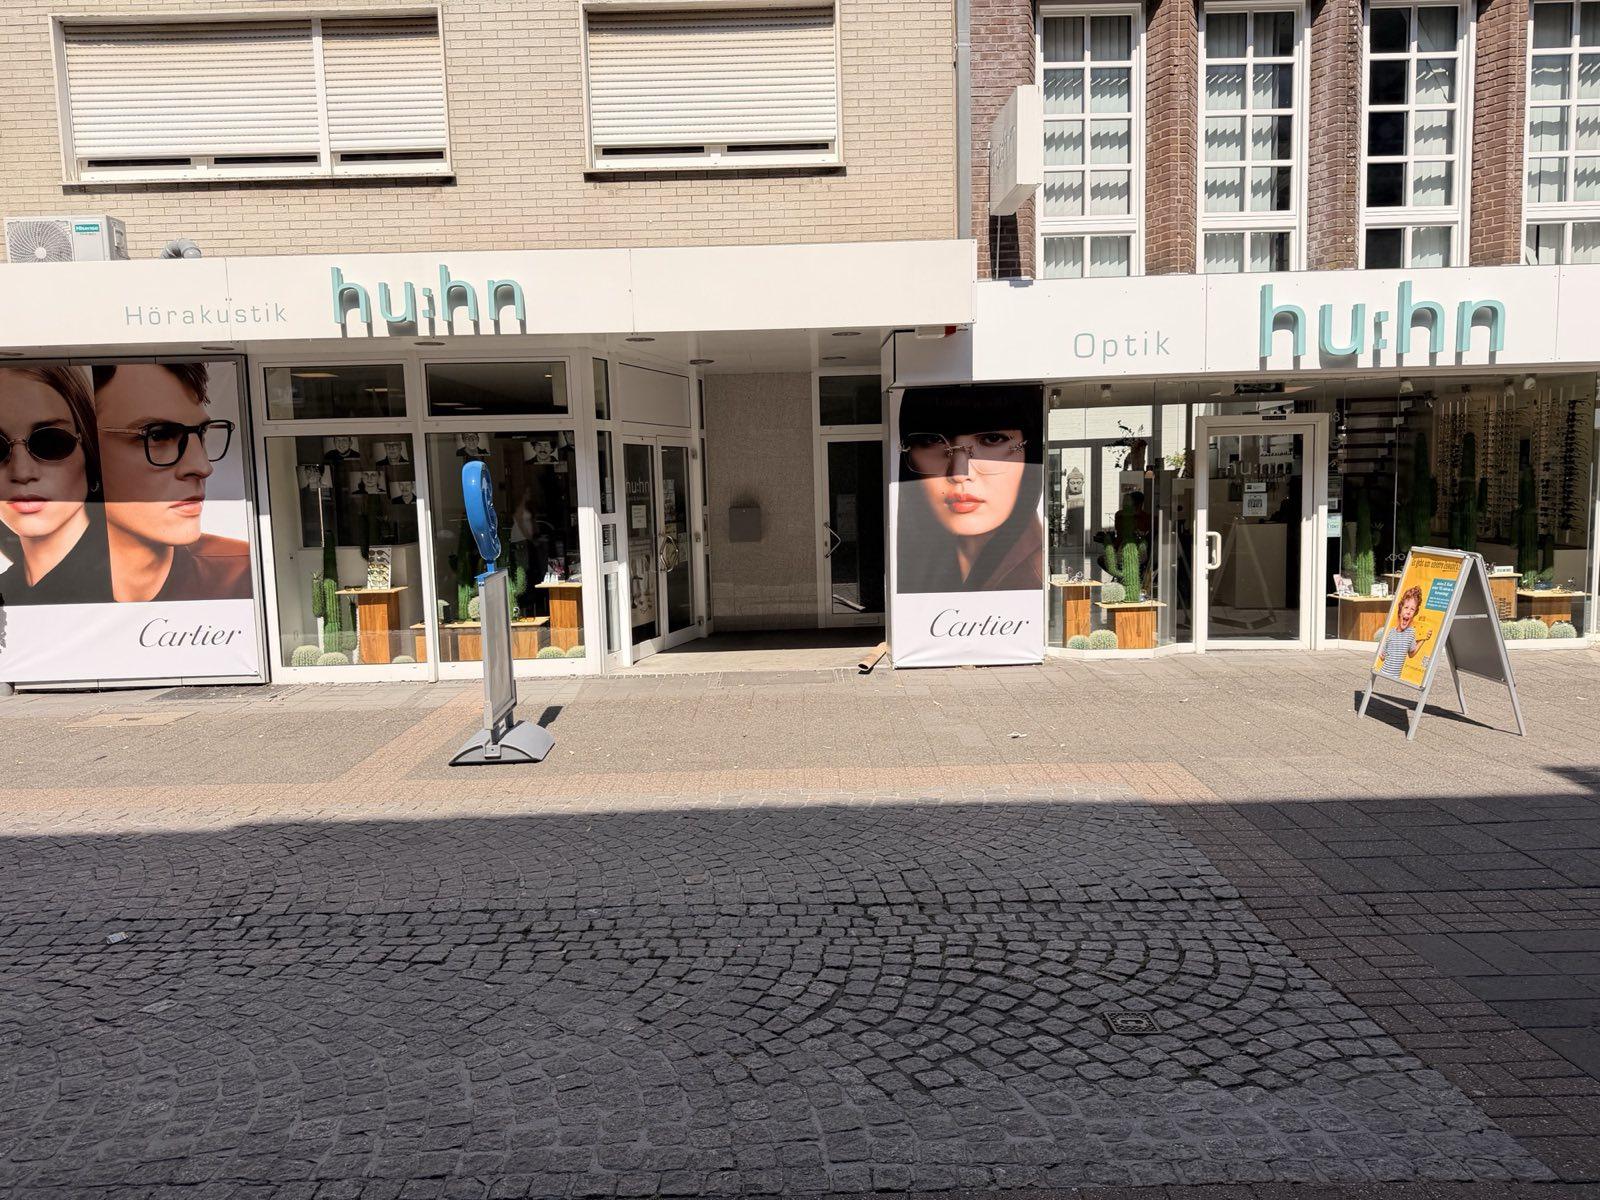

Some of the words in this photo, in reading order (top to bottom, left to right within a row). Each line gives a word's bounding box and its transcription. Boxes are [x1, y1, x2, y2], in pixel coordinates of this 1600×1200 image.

[125, 302, 288, 326] Hörakustik
[331, 264, 525, 325] hu:hn
[1073, 330, 1170, 363] Optik
[1259, 280, 1506, 358] hu:hn
[139, 617, 242, 648] Cartier
[930, 608, 1030, 638] Cartier
